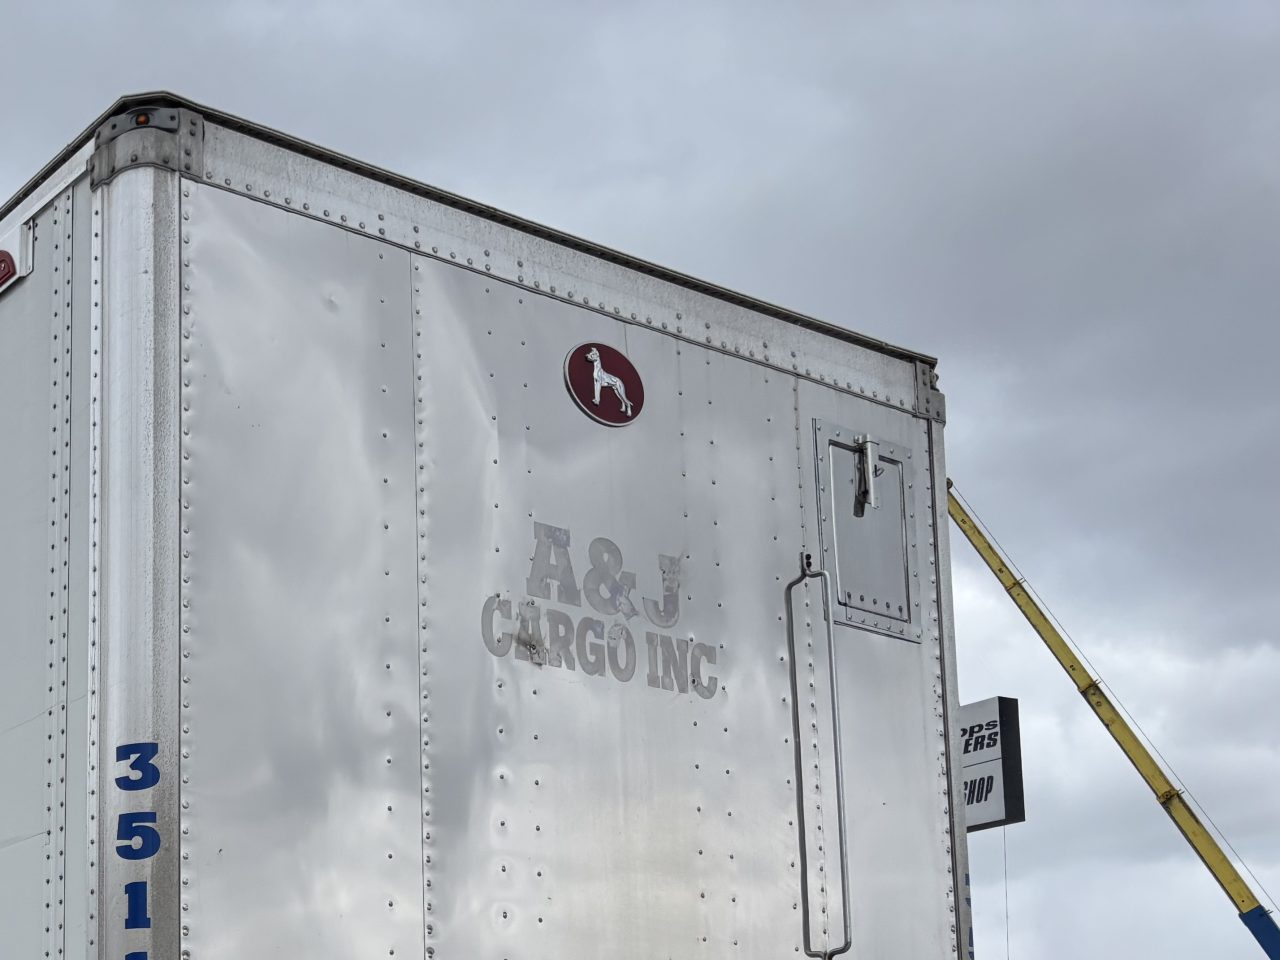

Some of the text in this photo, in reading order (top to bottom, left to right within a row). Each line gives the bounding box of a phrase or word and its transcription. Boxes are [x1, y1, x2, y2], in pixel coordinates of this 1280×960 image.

[526, 521, 681, 629] A&J
[481, 595, 718, 700] CARGO INC
